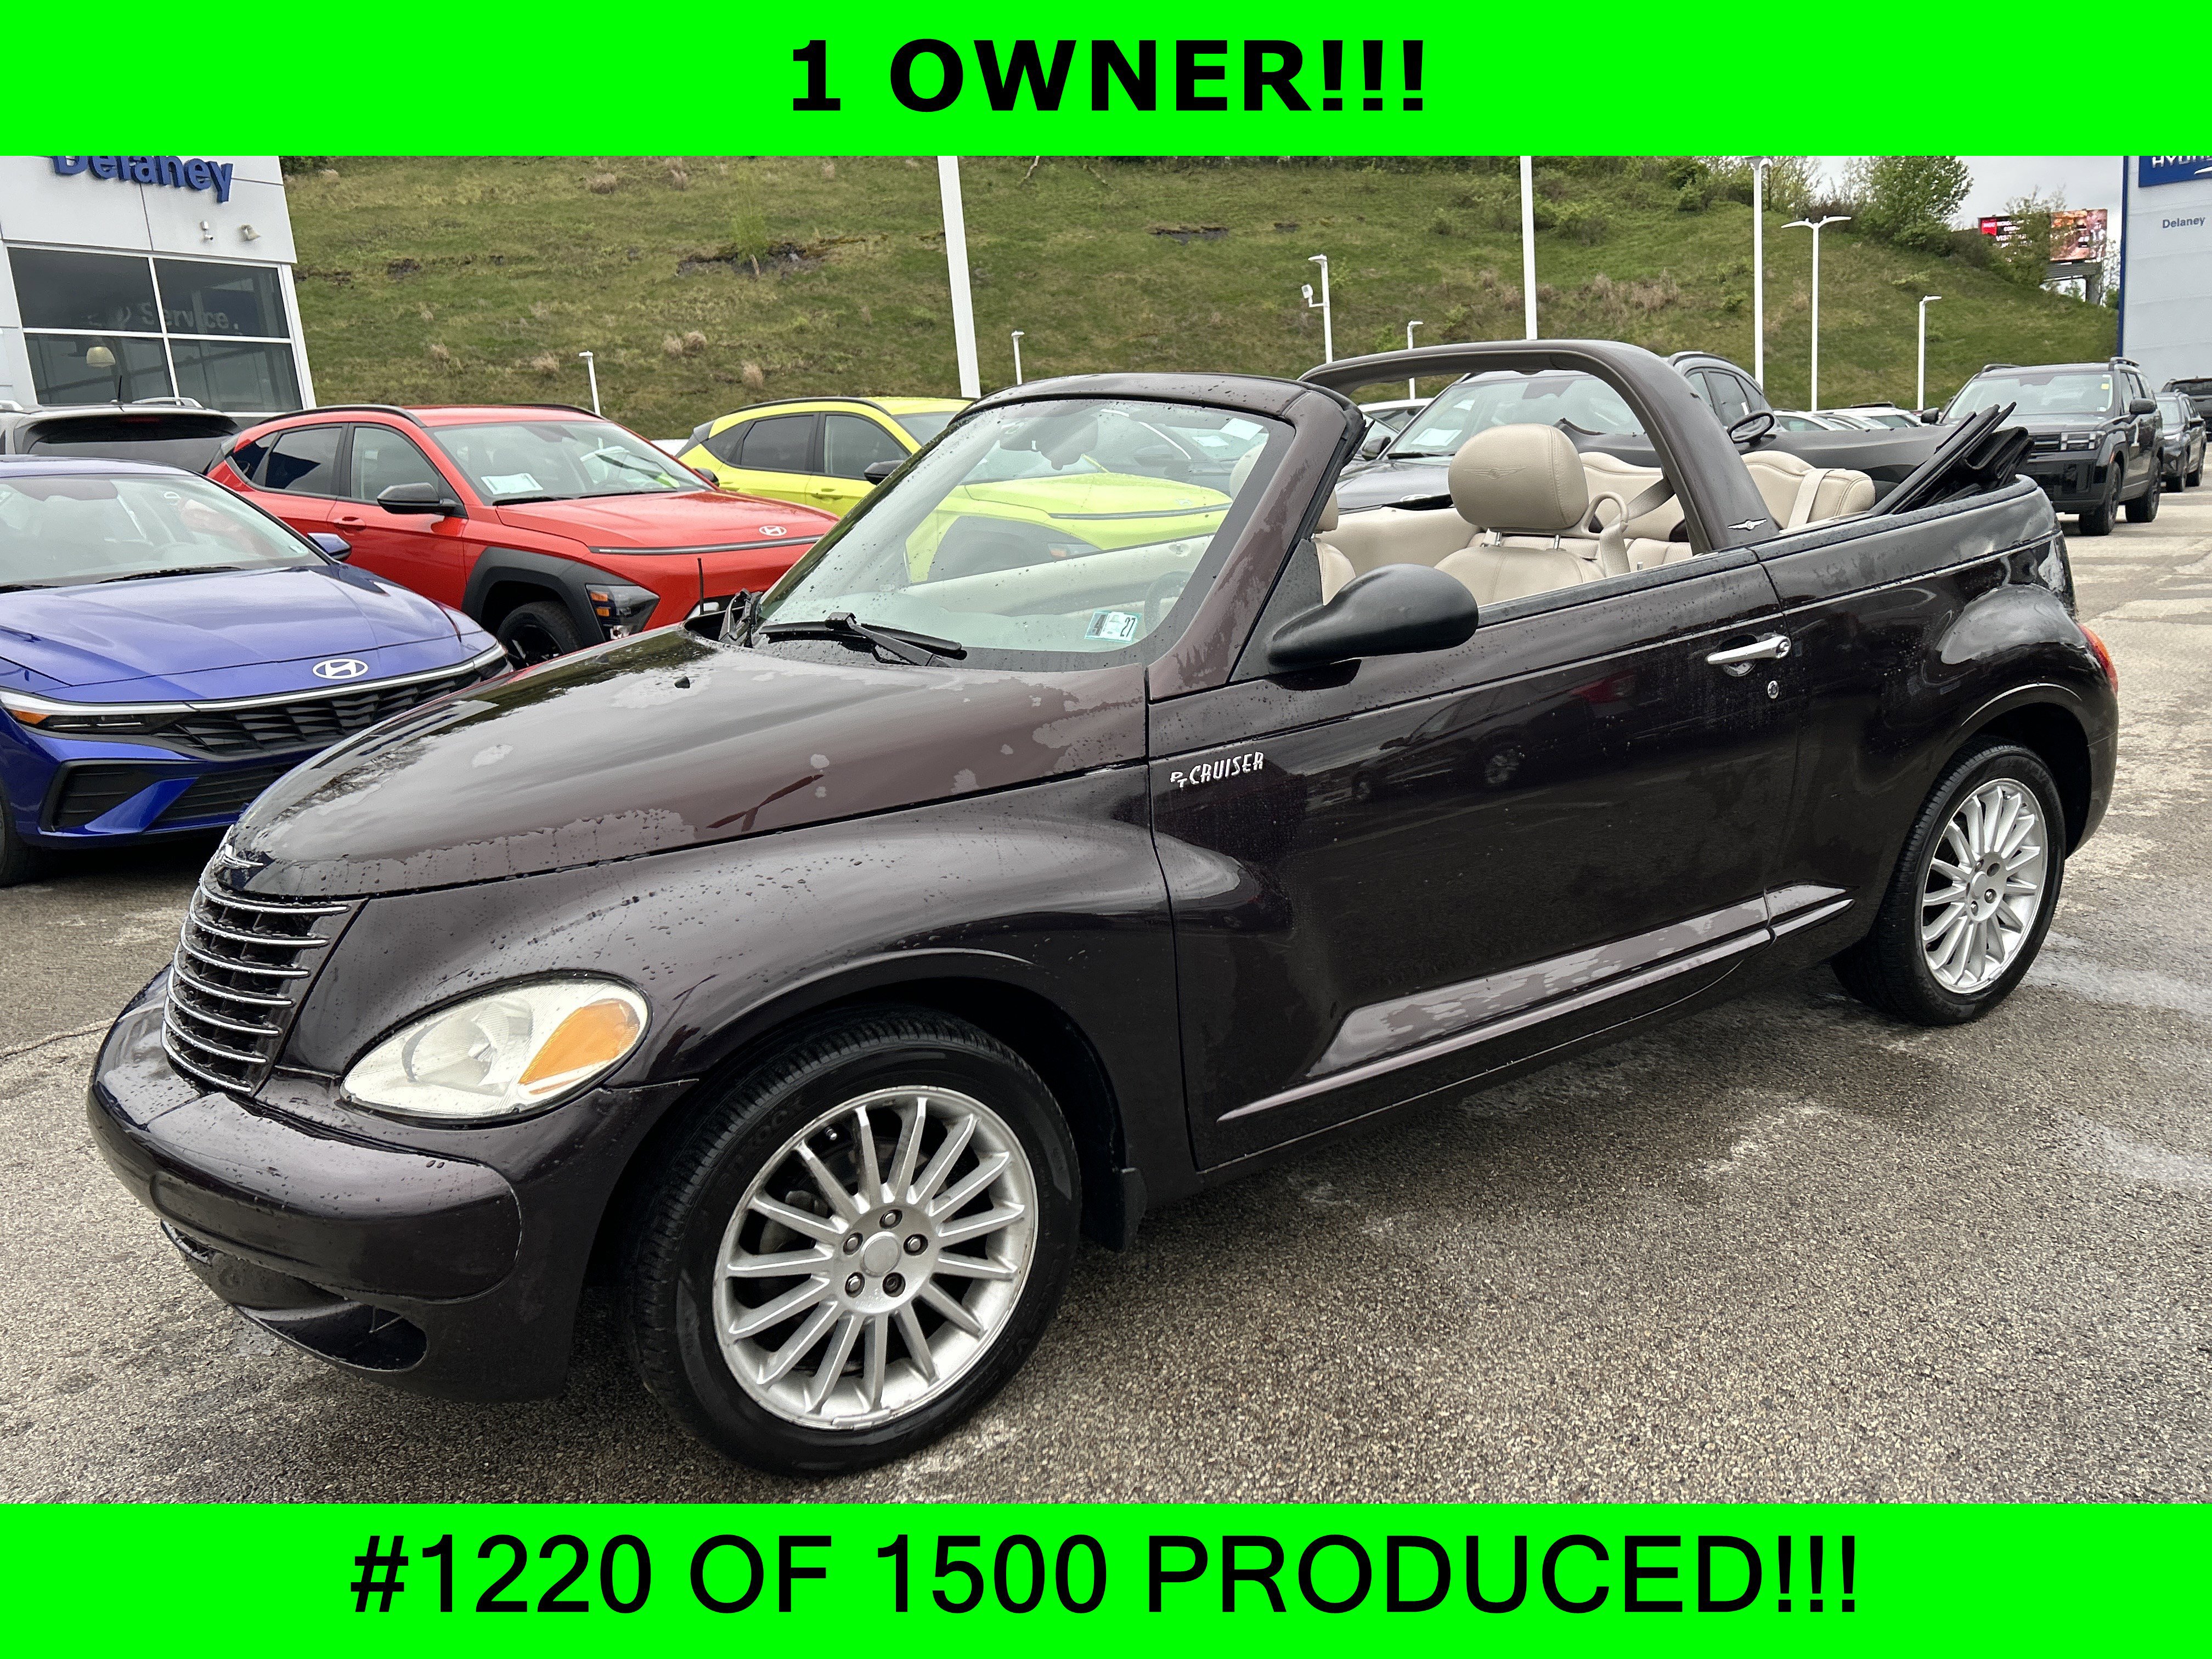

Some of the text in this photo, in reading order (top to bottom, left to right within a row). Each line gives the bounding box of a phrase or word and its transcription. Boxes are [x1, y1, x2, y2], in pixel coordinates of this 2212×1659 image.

[2162, 217, 2205, 228] Delaney
[1120, 617, 1136, 637] 27
[1170, 752, 1263, 788] PT CRUISER
